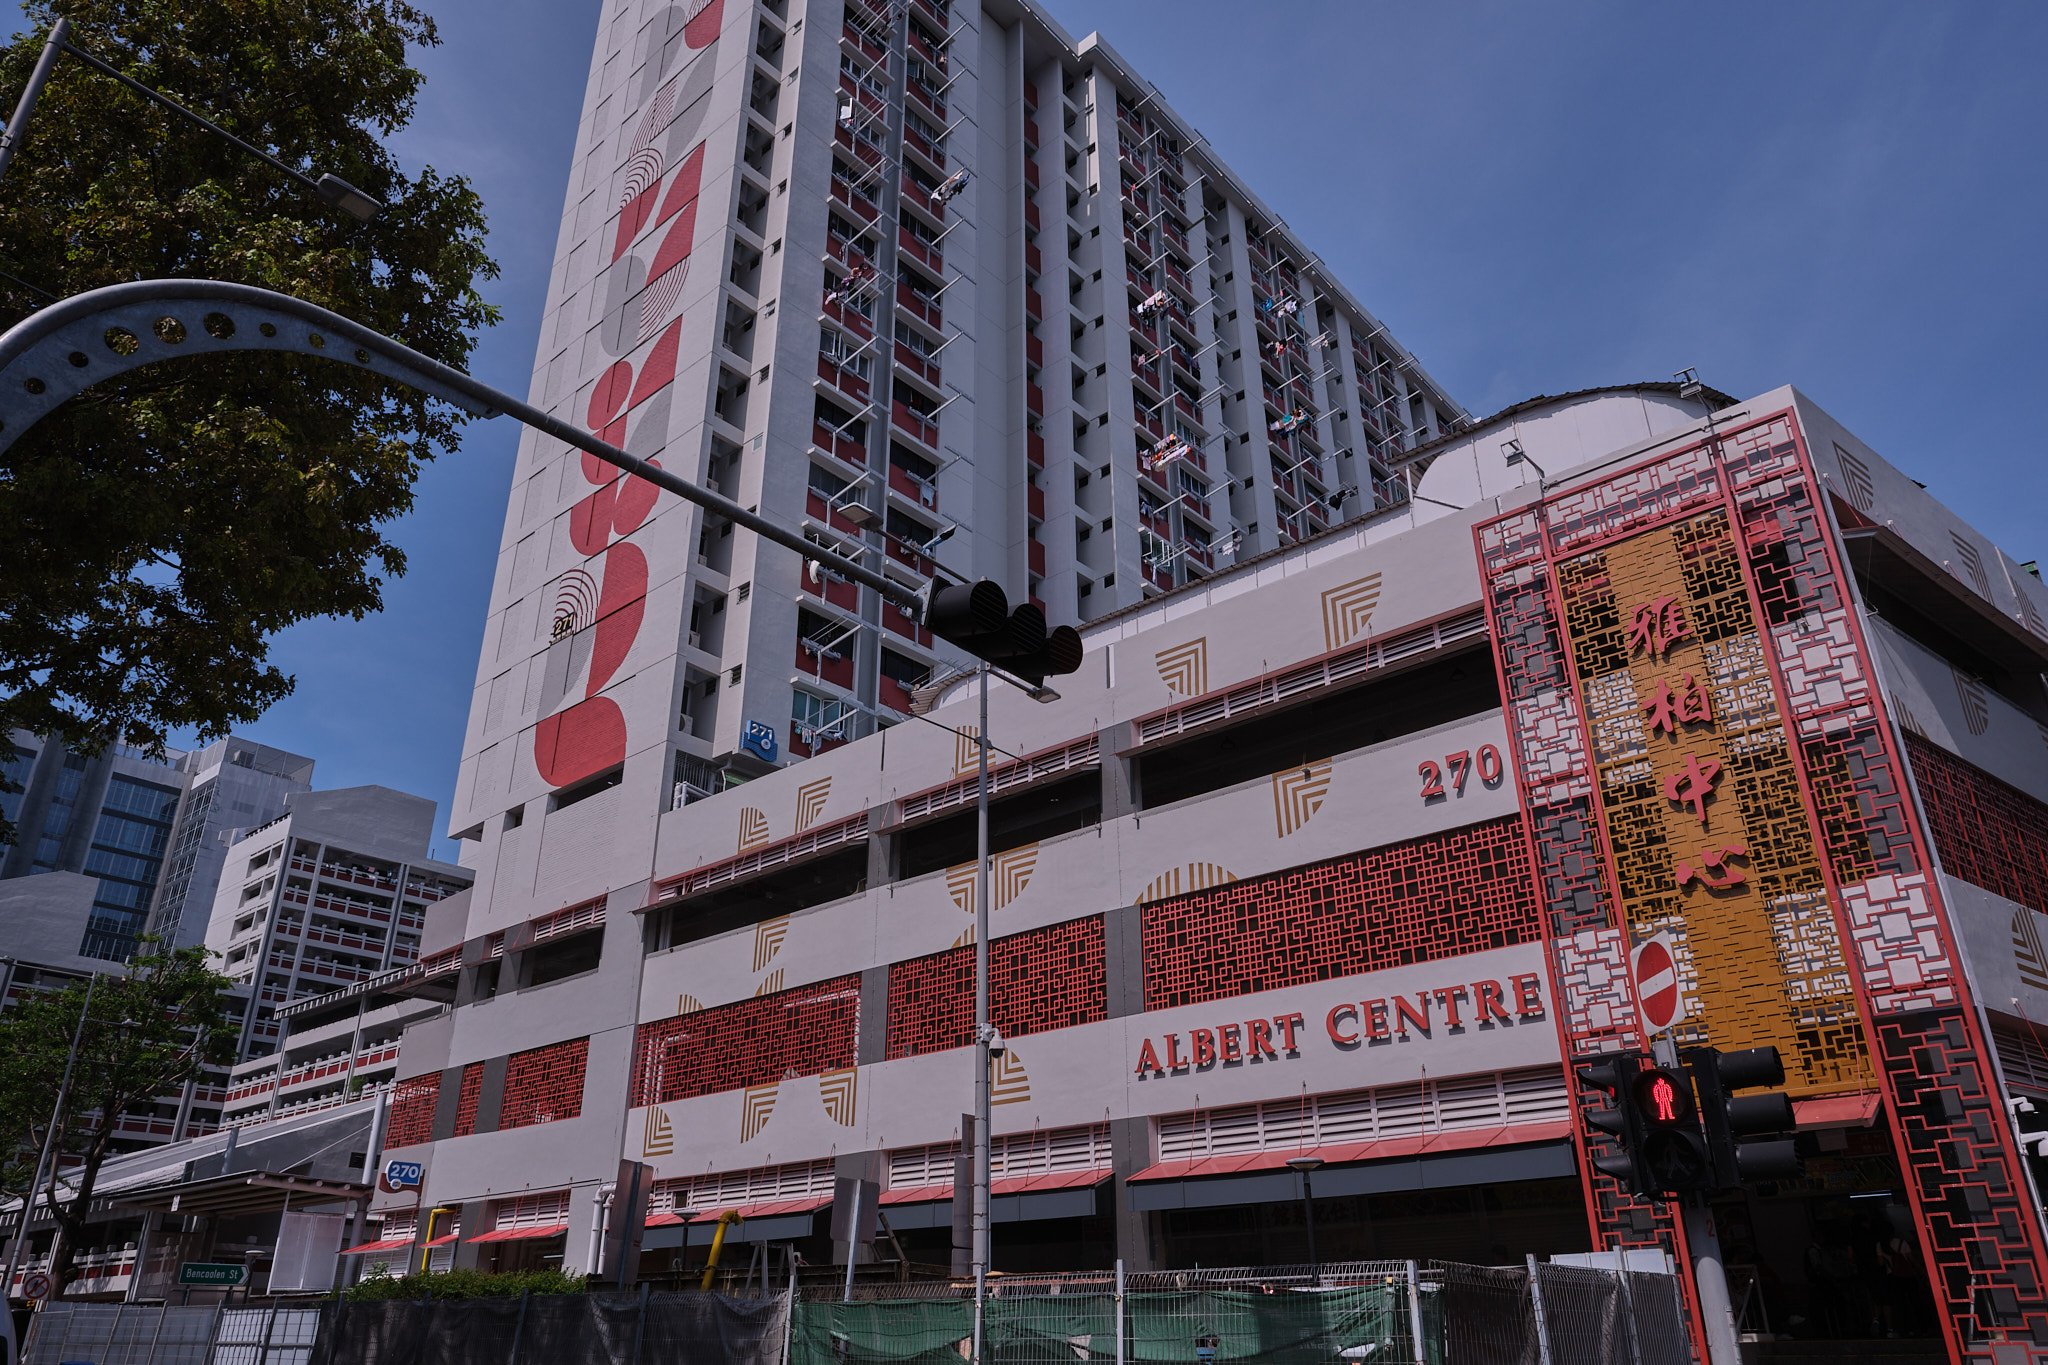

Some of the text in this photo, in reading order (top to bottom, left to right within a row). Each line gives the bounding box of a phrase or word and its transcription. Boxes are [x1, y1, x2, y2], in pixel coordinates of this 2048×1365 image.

[554, 614, 574, 635] 271
[750, 723, 773, 741] 271
[1627, 594, 1747, 887] 雅柏中心
[1417, 743, 1501, 798] 270
[1134, 972, 1544, 1074] ALBERT CENTRE
[390, 1164, 420, 1179] 270
[1706, 1219, 1716, 1238] 2
[185, 1268, 239, 1280] Bencoolen St
